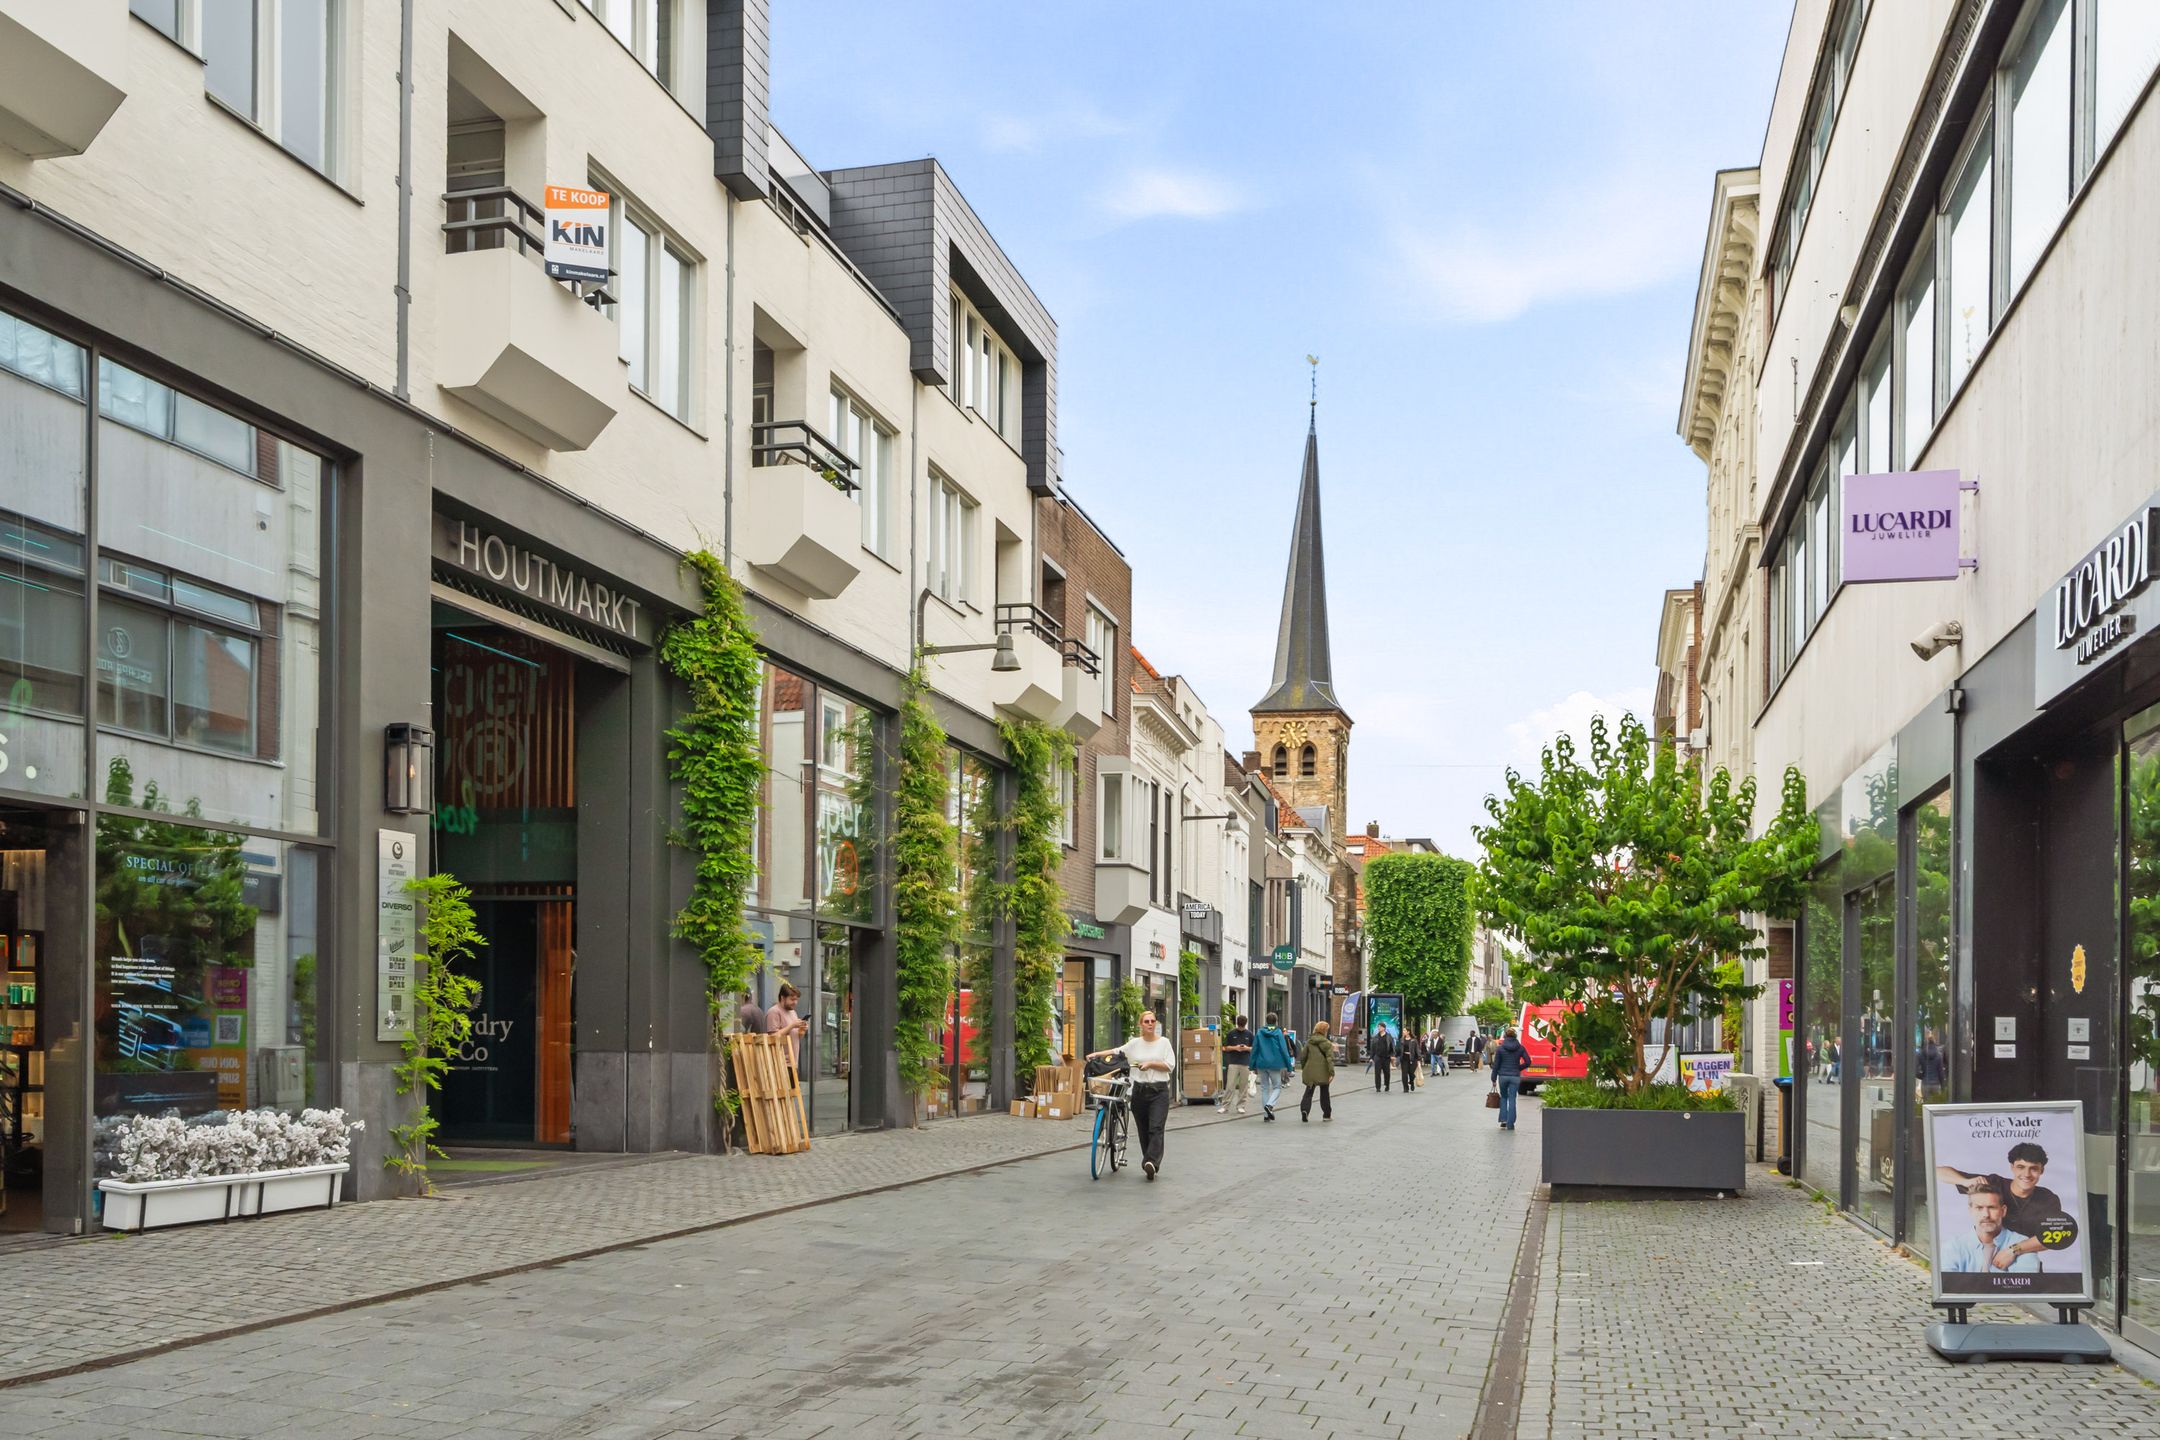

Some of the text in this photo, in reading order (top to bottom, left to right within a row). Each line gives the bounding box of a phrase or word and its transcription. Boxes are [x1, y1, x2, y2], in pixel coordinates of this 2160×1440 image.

[551, 188, 606, 206] TE KOOP
[1851, 509, 1952, 533] LUCARDI
[1871, 530, 1932, 541] JUWELIER
[460, 520, 641, 638] HOUTMARKT
[2054, 507, 2150, 650] LUCARDI
[2075, 614, 2121, 666] JUWELIER
[126, 855, 175, 873] SPECIAL
[382, 901, 413, 911] DIVERSO
[1185, 903, 1211, 911] AMERICA
[458, 1040, 489, 1062] Co
[1684, 1060, 1731, 1071] VLAGGEN
[1697, 1070, 1720, 1081] LIJN
[1968, 1115, 2043, 1130] Geef je Vader
[1971, 1127, 2042, 1140] een extraatje
